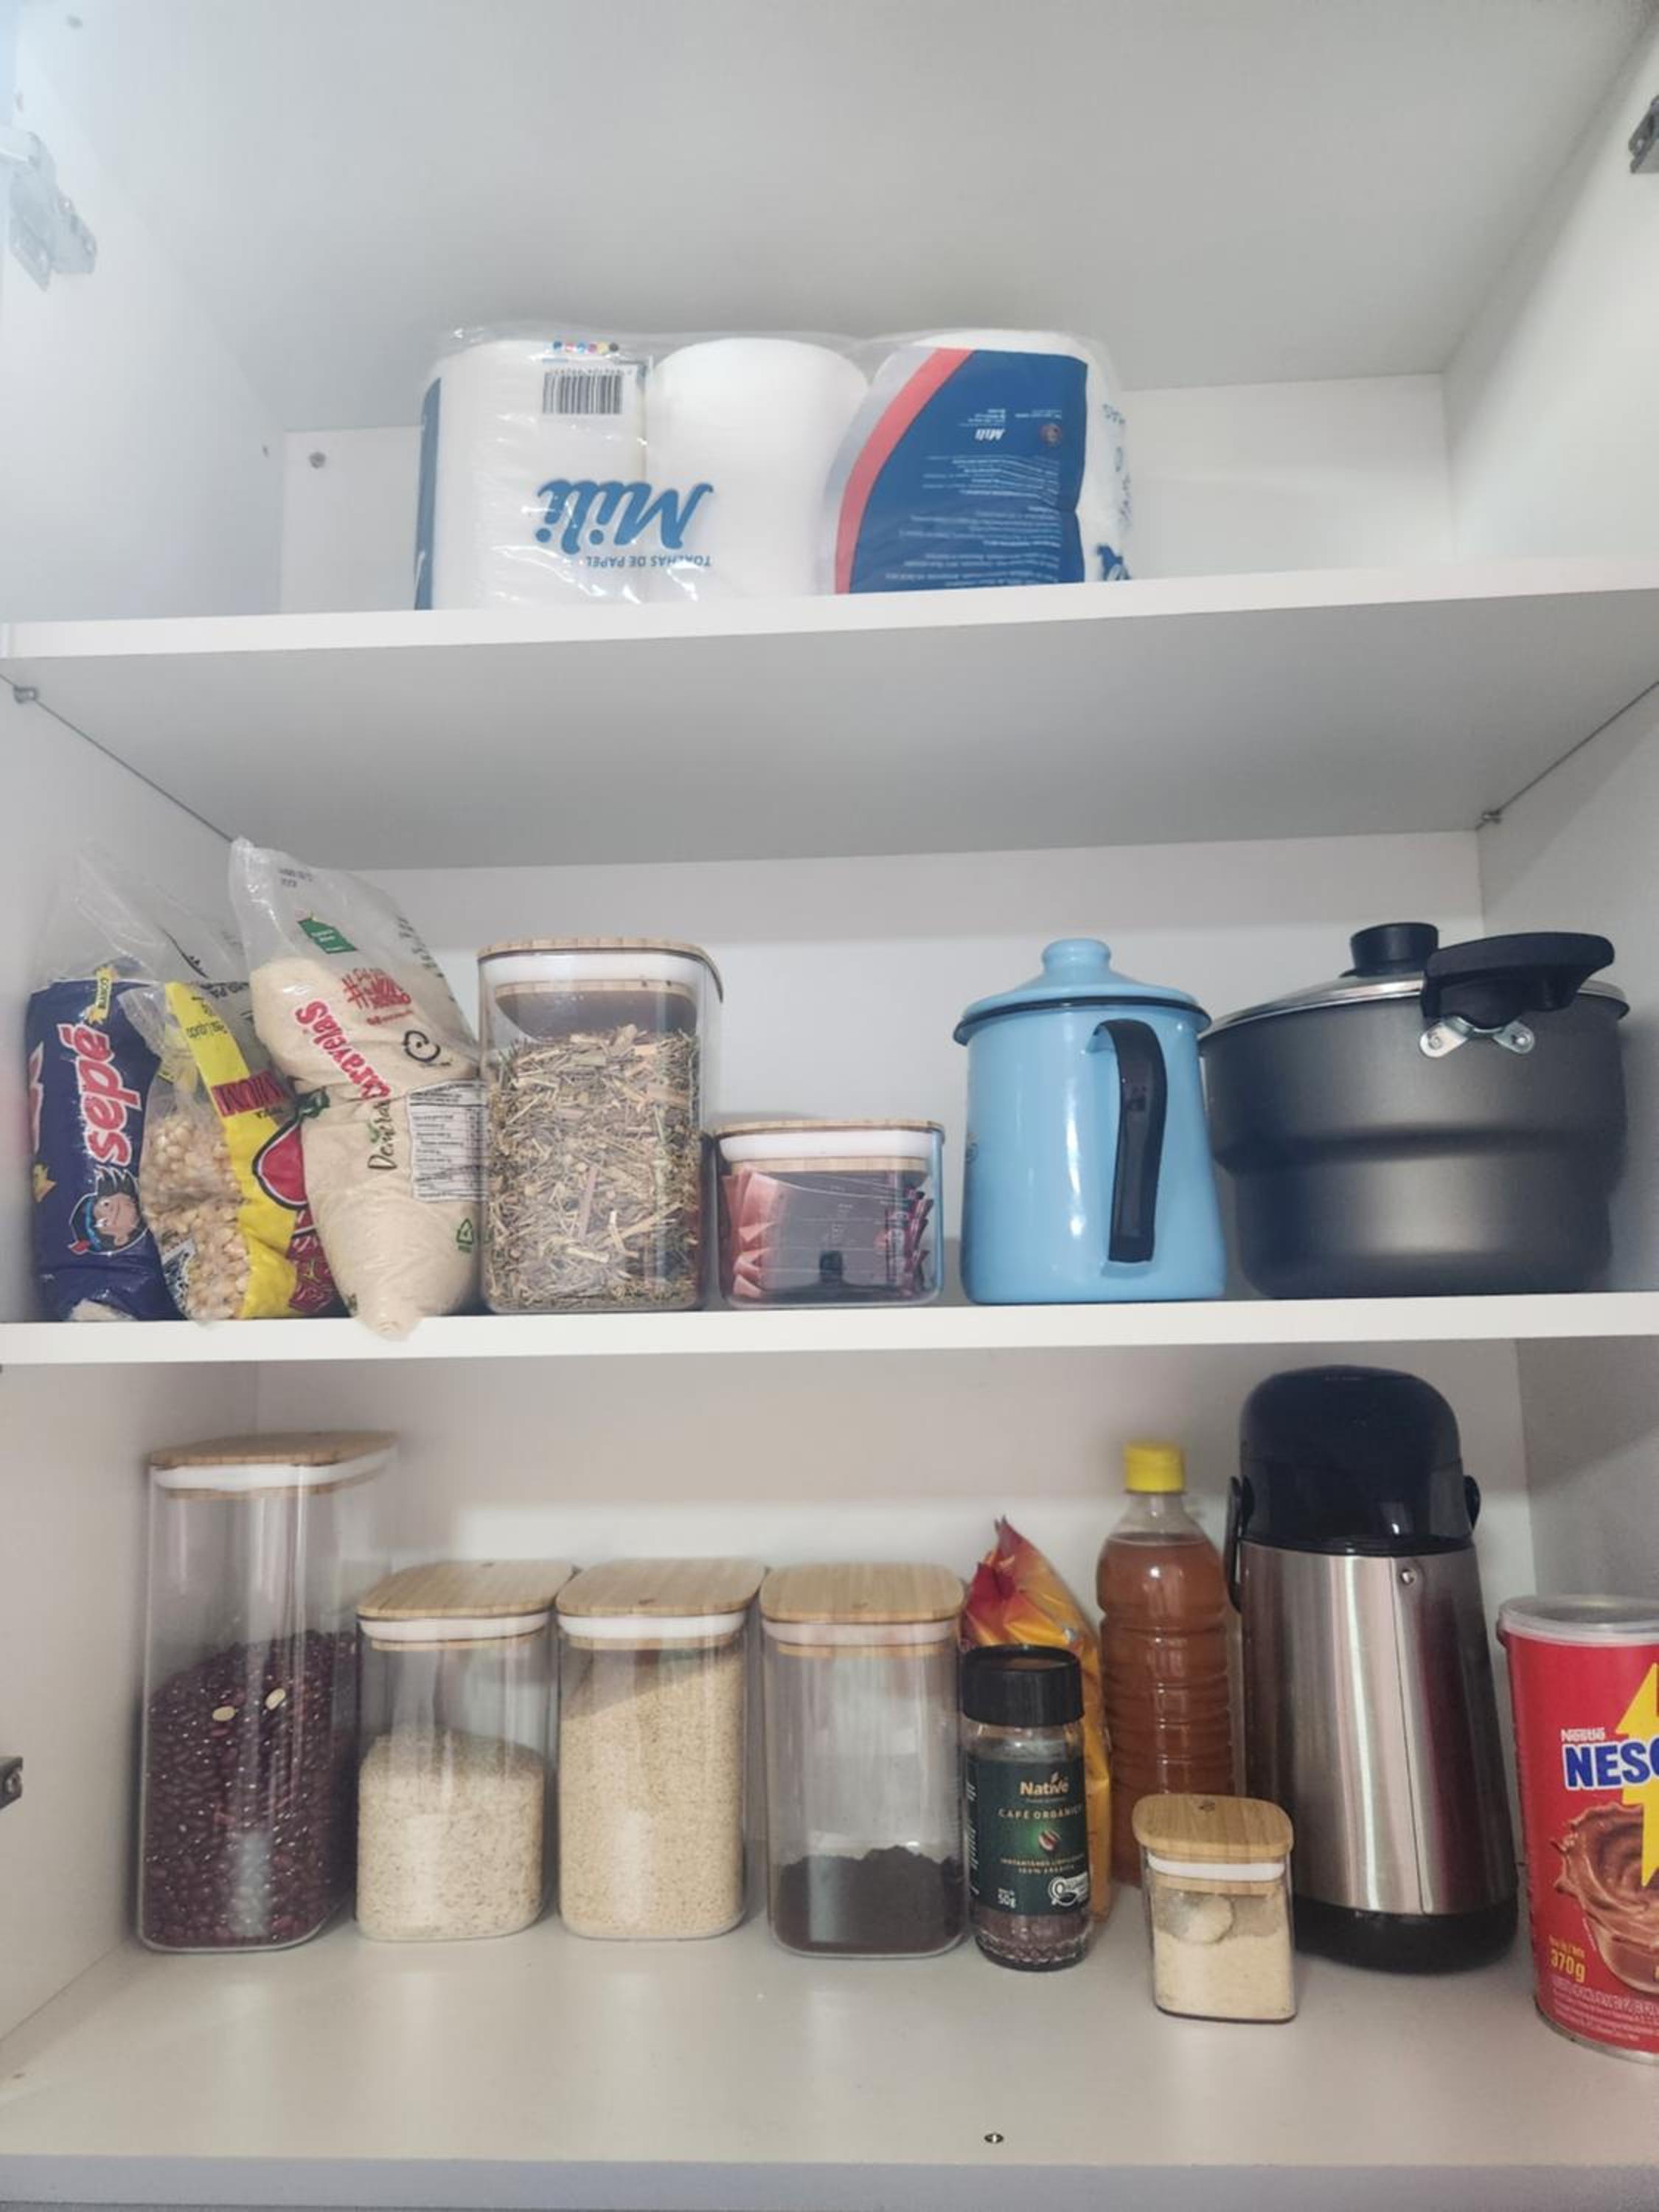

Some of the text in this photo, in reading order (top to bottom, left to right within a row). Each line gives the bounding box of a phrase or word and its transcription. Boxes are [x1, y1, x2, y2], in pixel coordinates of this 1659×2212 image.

[535, 479, 714, 555] Mili
[585, 554, 627, 568] PAPEL
[629, 555, 647, 568] DE
[56, 1022, 142, 1167] sepé
[1019, 1779, 1070, 1795] Native
[1551, 1949, 1585, 1983] 370g
